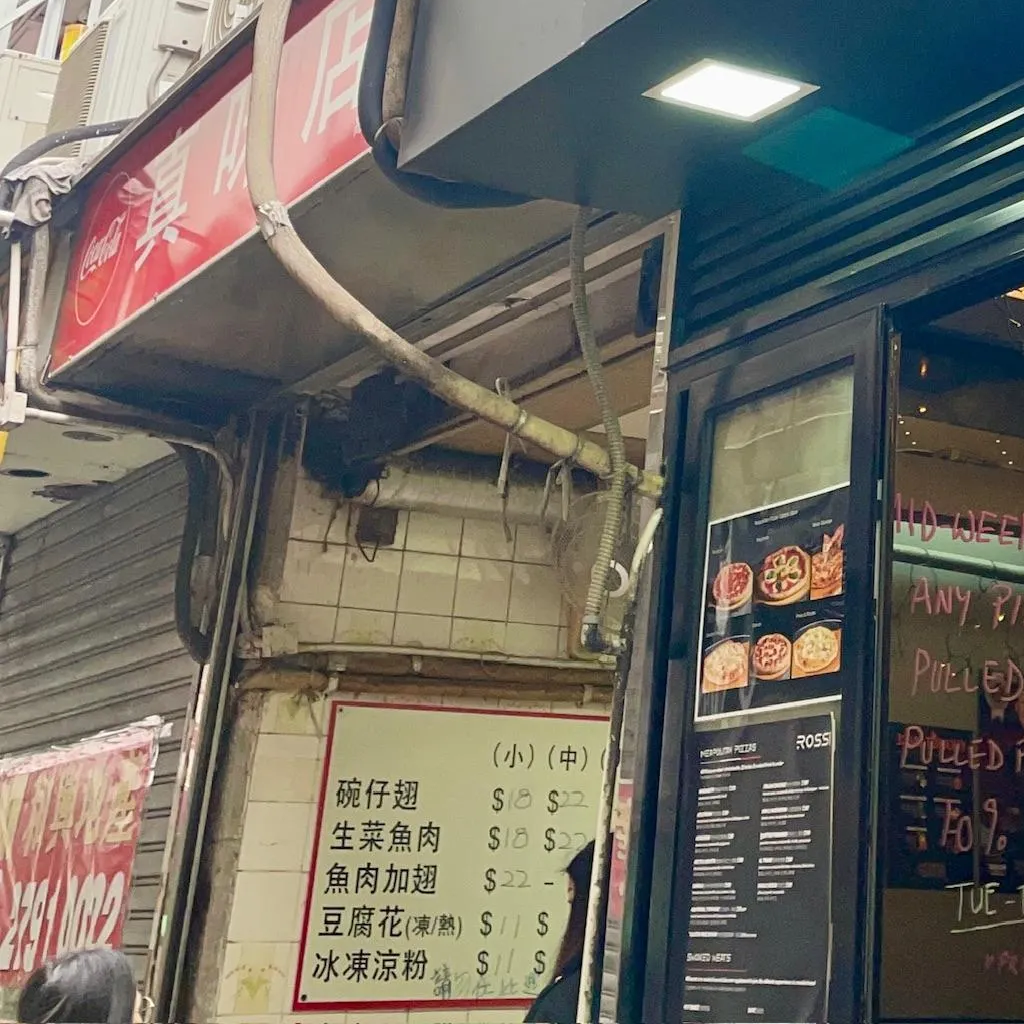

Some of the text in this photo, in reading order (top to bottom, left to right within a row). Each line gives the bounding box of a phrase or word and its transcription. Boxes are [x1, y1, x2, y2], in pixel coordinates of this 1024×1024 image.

[911, 576, 971, 627] ANY
[493, 742, 535, 769] (小)
[547, 744, 588, 772] (中)
[901, 726, 1005, 771] PULLED
[335, 778, 419, 811] 碗仔翅
[329, 820, 441, 853] 生菜魚肉
[324, 862, 437, 895] 魚肉加翅
[312, 949, 428, 983] 冰凍涼粉
